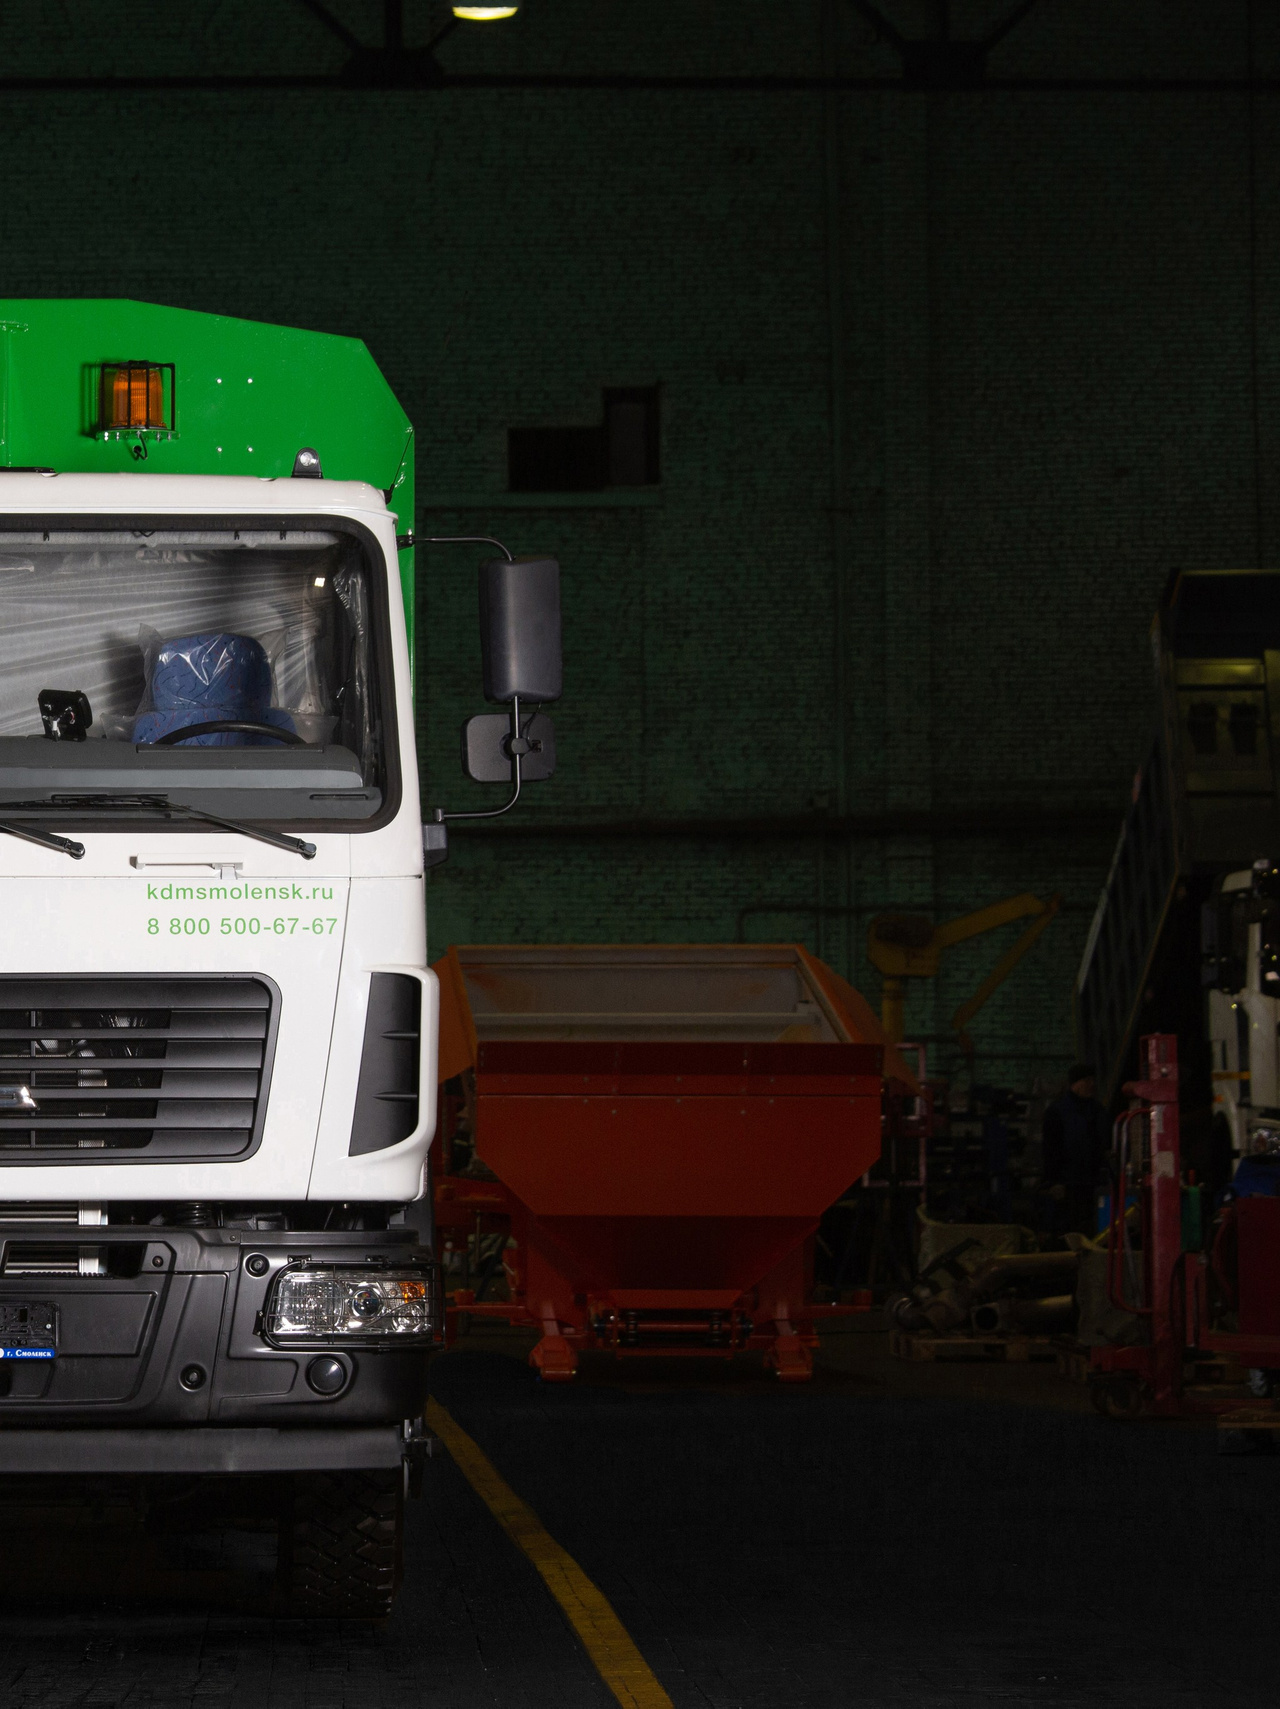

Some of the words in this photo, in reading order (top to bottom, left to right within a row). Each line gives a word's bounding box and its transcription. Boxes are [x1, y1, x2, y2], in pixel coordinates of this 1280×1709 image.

[147, 883, 334, 900] kdmsmolensk.ru
[147, 918, 160, 935] 8
[169, 918, 211, 935] 800
[220, 918, 338, 935] 500-67-67
